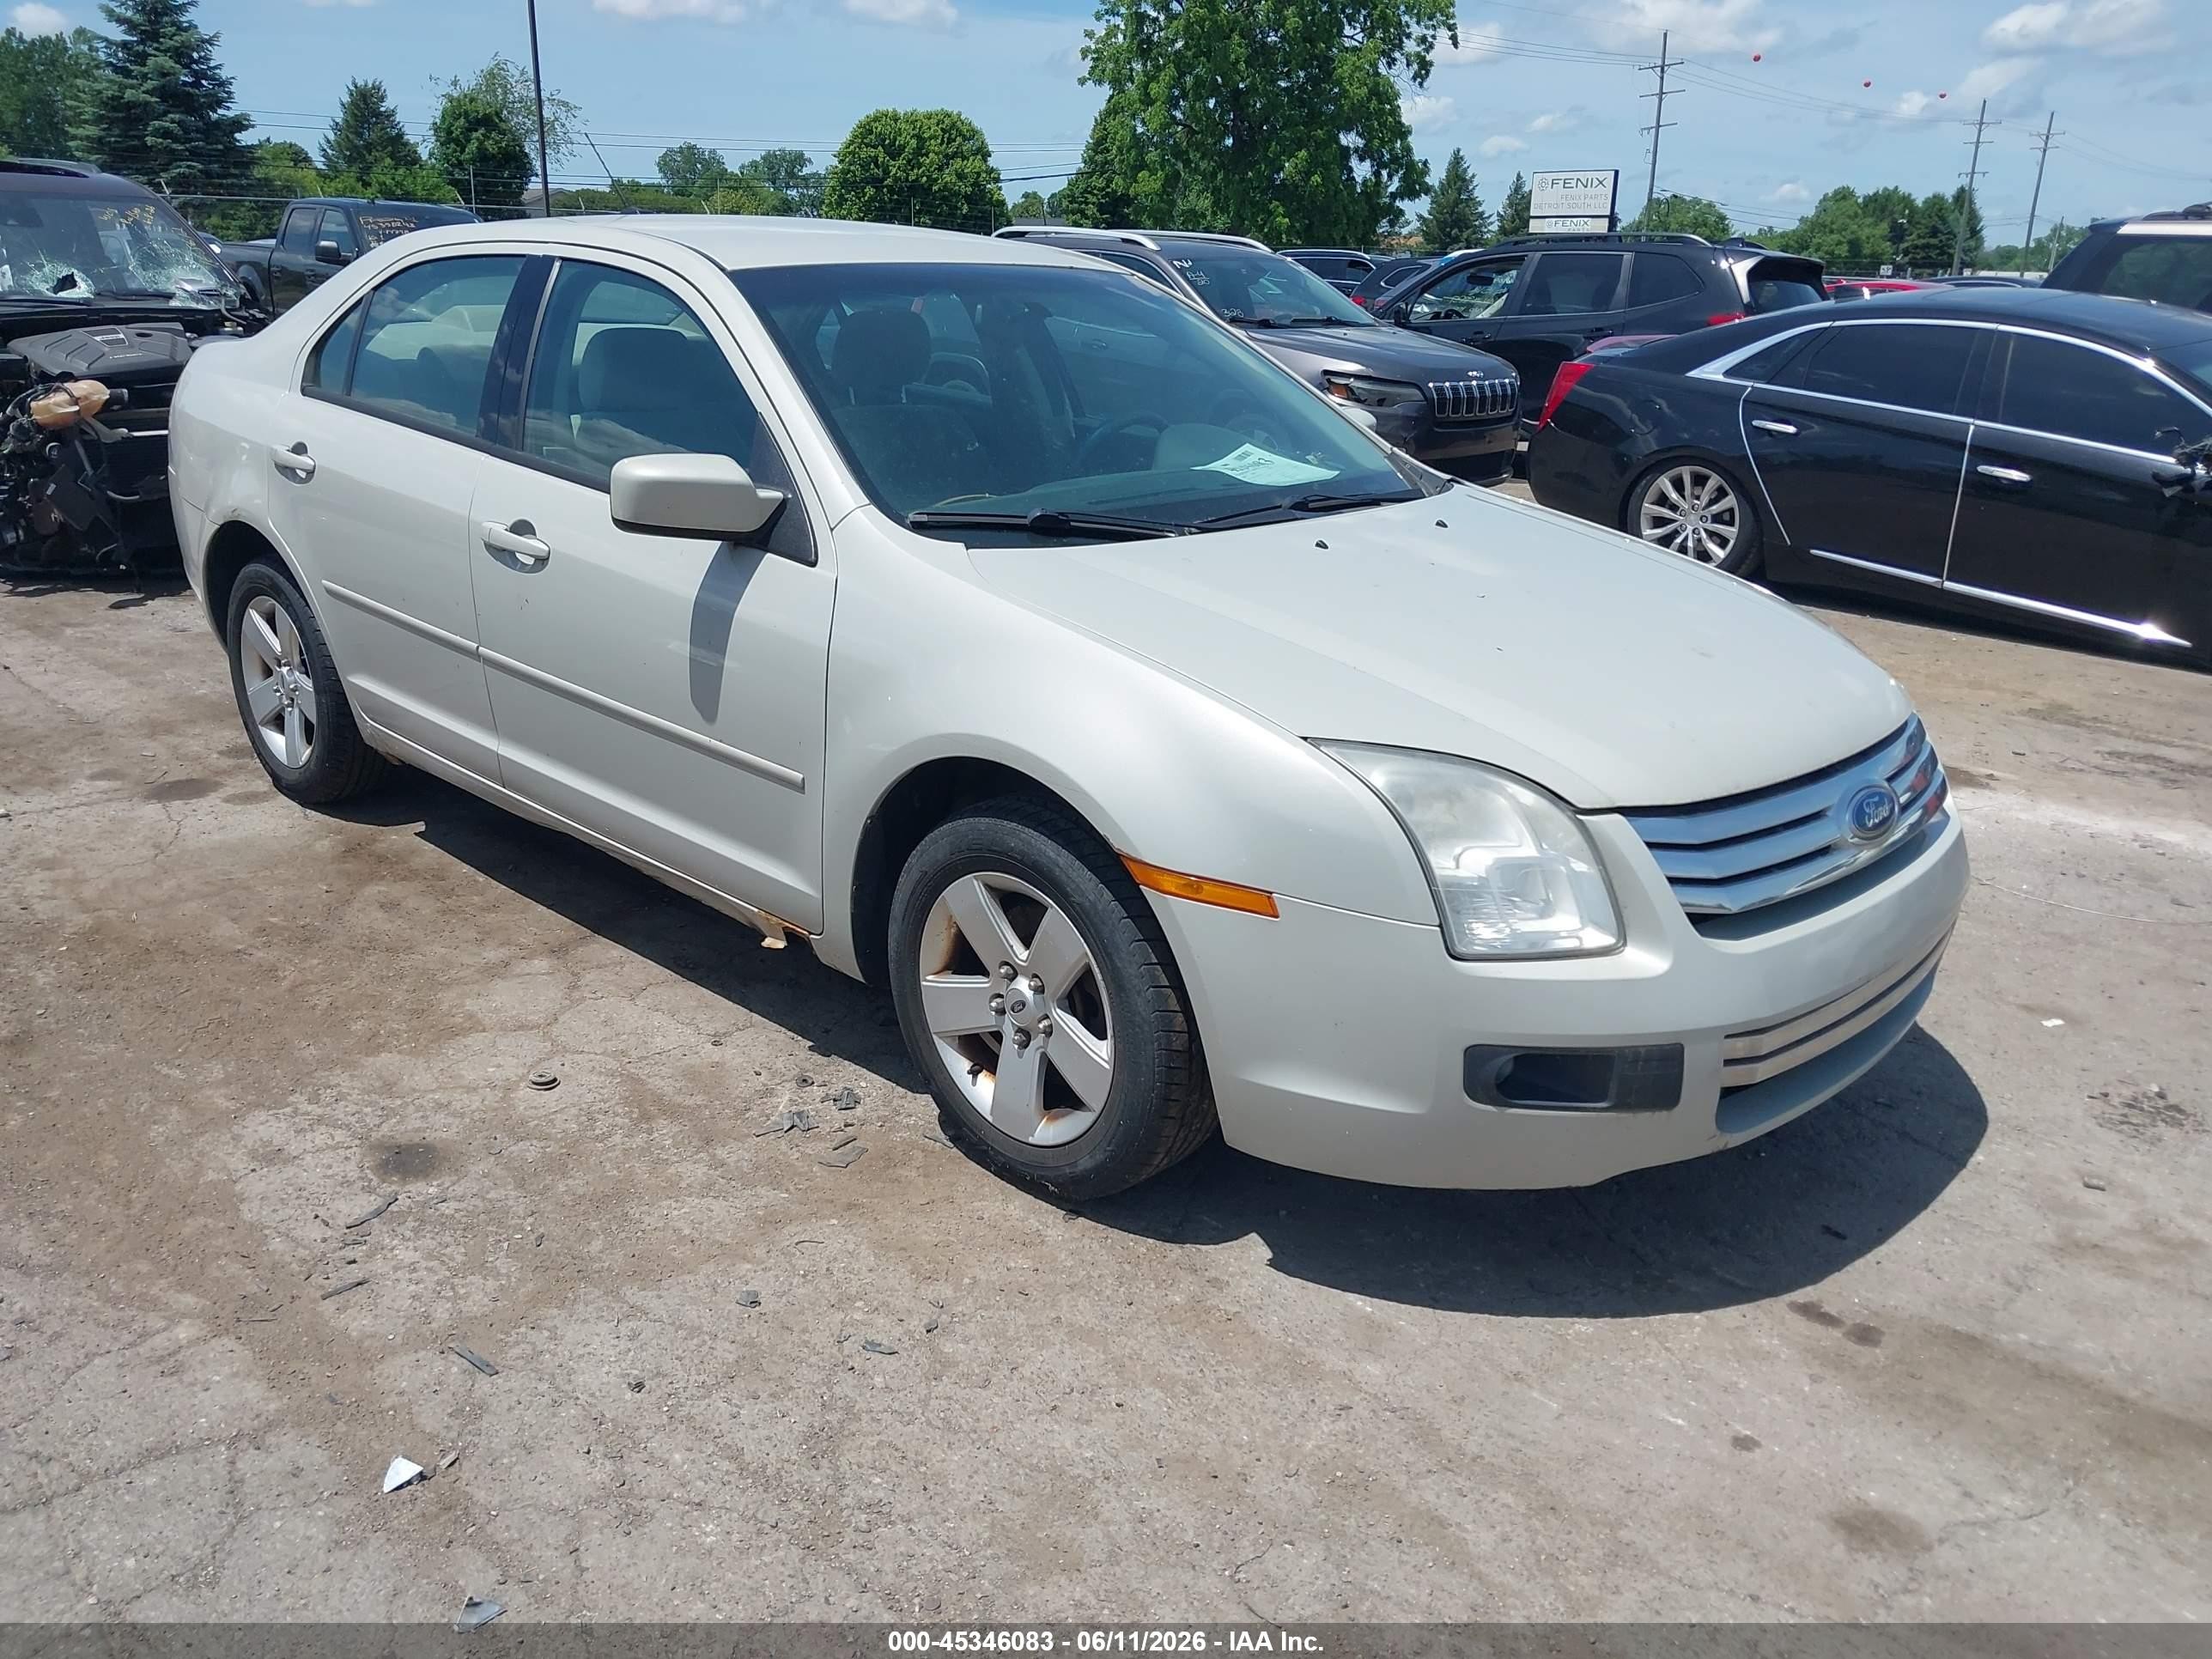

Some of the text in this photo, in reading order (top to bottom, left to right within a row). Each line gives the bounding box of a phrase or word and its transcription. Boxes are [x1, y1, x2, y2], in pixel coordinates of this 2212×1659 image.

[1551, 177, 1607, 189] FENIX
[1553, 219, 1590, 228] FENIX
[1863, 795, 1892, 827] Ford
